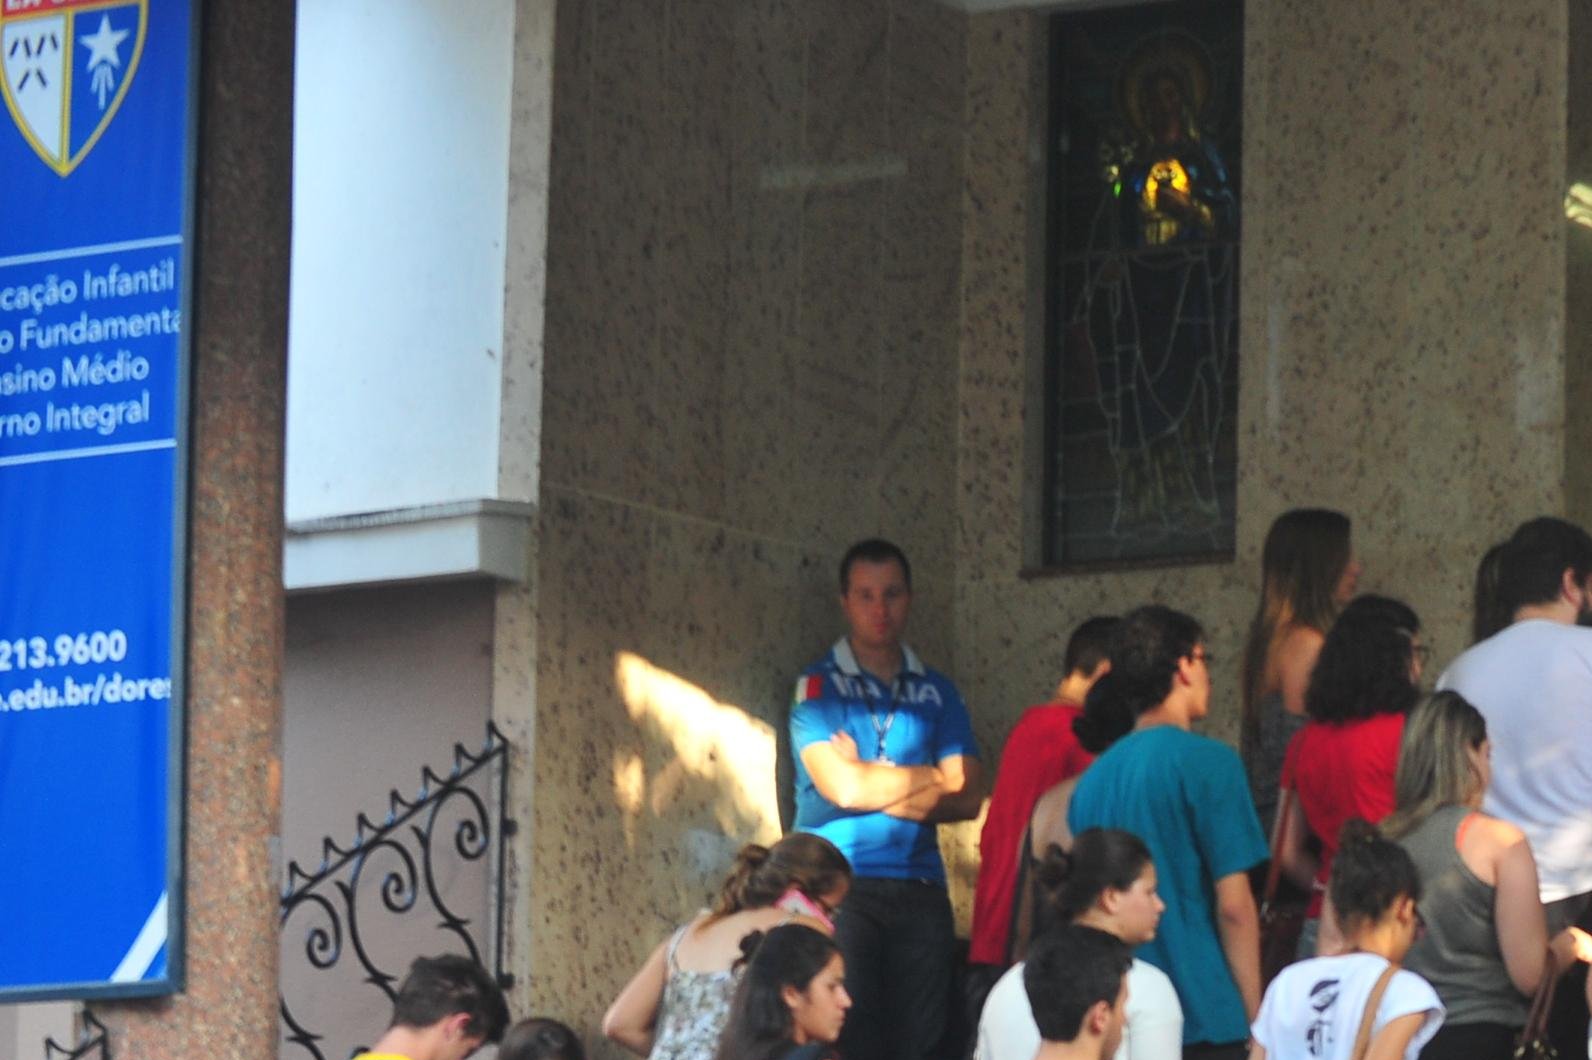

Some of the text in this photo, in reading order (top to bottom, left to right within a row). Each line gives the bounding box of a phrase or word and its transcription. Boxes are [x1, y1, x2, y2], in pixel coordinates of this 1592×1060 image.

[0, 256, 174, 315] cação Infantil
[0, 348, 150, 396] sino Médio
[46, 388, 149, 436] Integral
[0, 629, 127, 672] 213.9600
